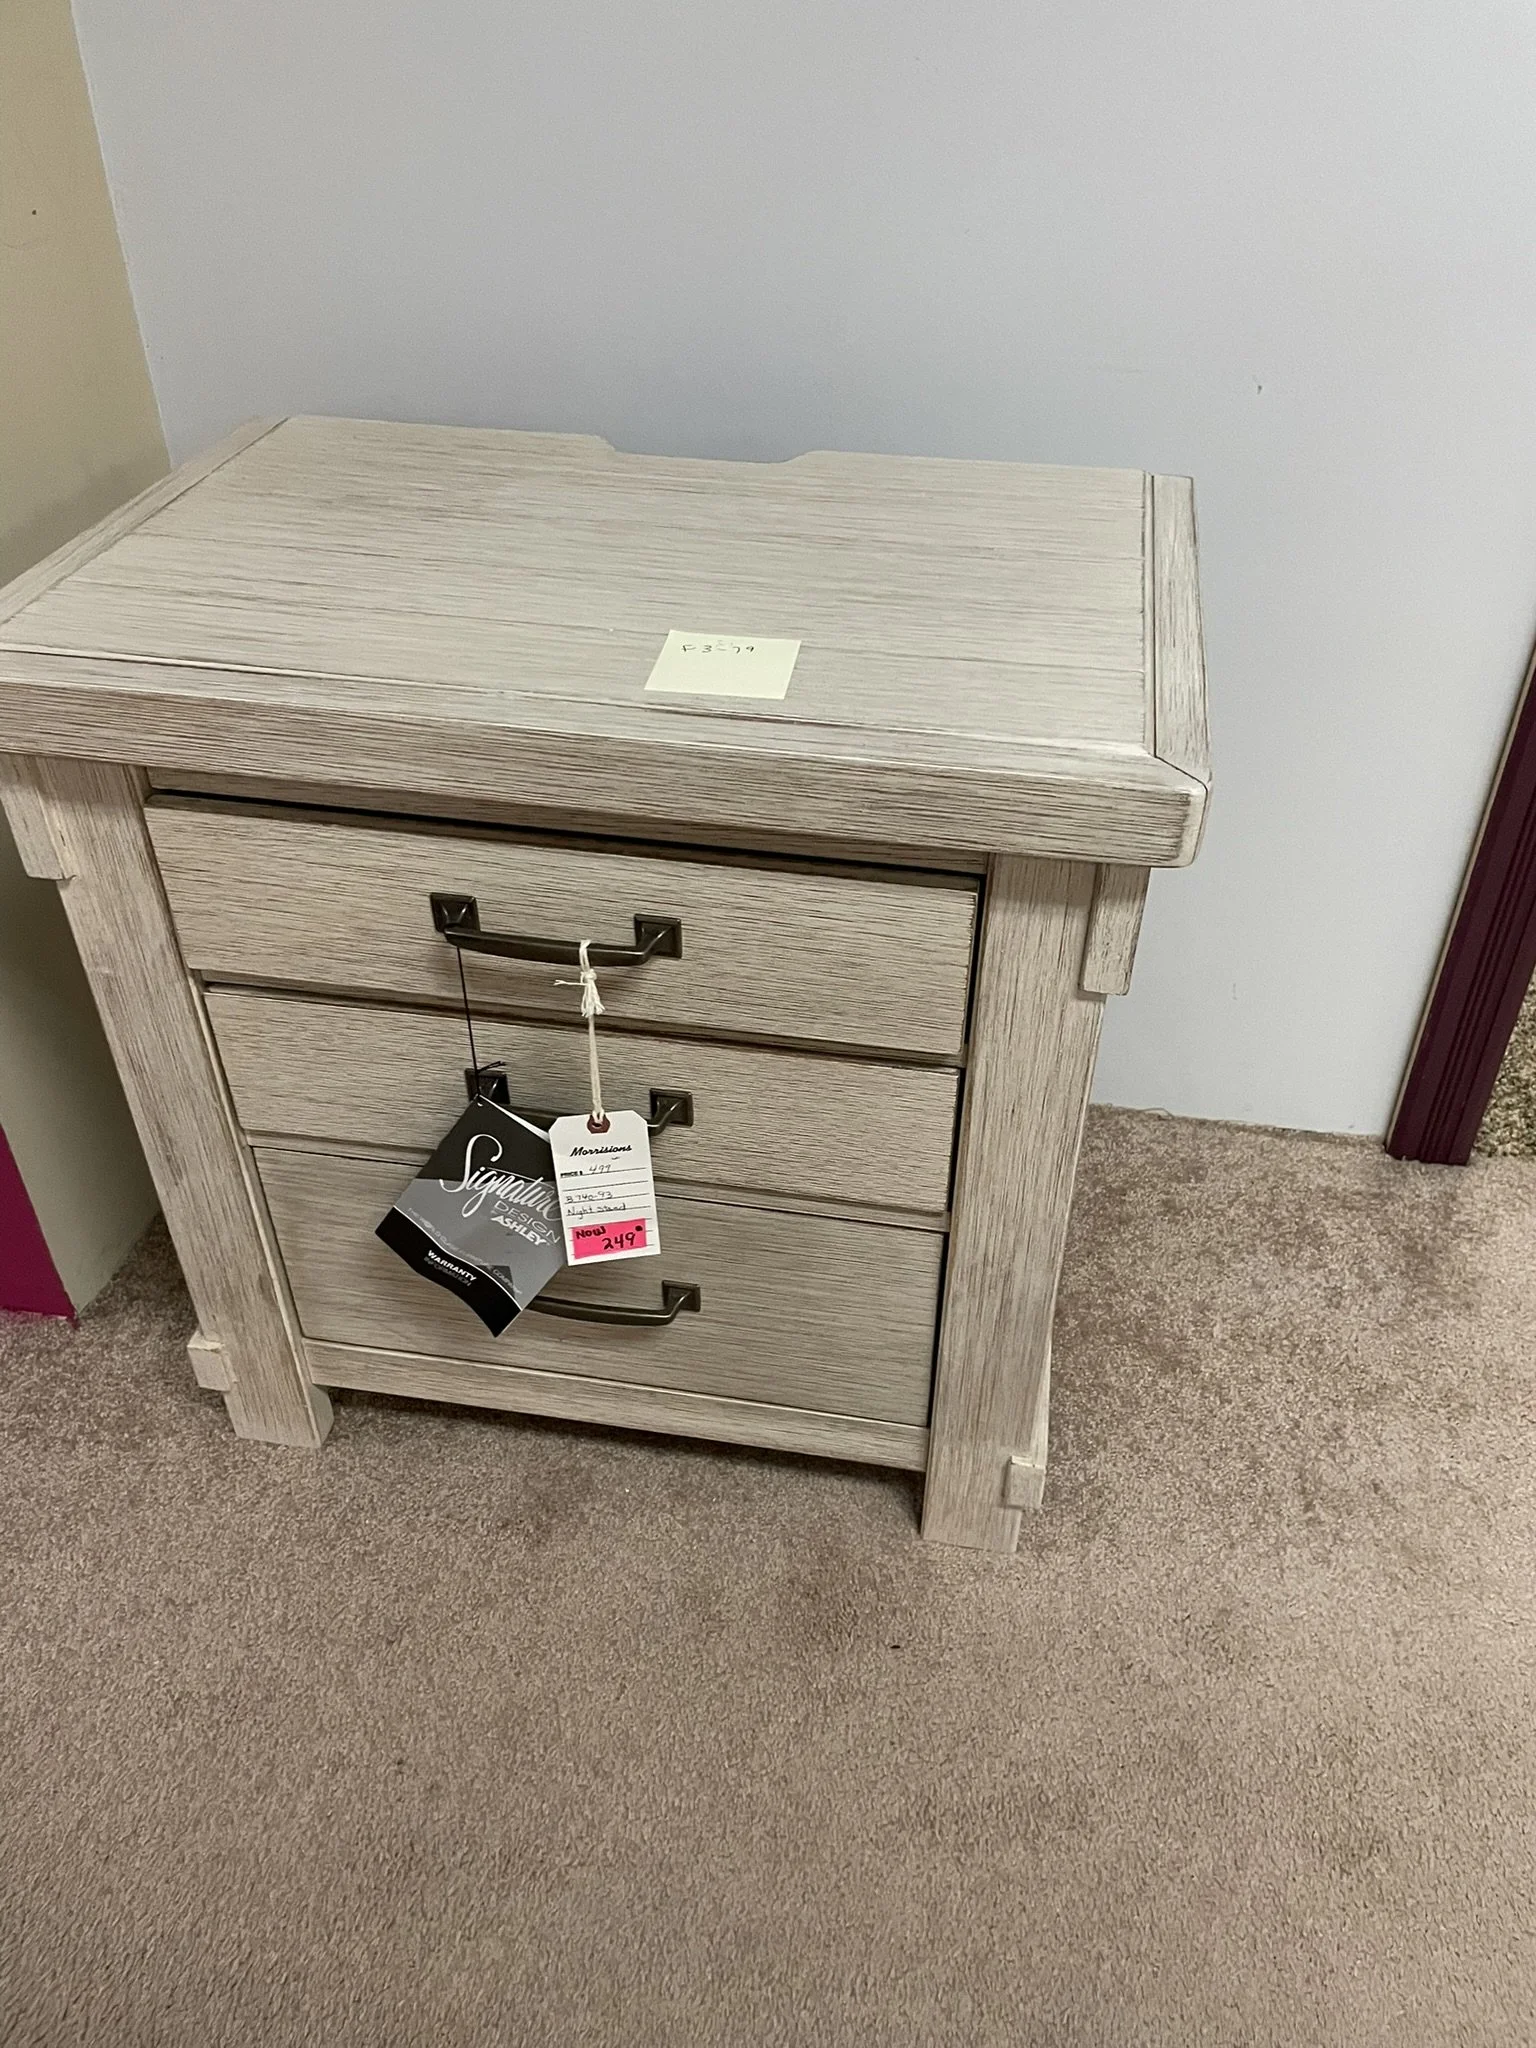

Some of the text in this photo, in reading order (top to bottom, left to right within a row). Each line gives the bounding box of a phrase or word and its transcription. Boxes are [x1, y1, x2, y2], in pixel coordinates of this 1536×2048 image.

[570, 1144, 632, 1157] Morrisions
[439, 1133, 562, 1218] Signature
[494, 1200, 561, 1243] DESIGN
[567, 1206, 593, 1220] Night
[490, 1215, 547, 1246] ASHLEY
[427, 1249, 477, 1282] WARRANTY
